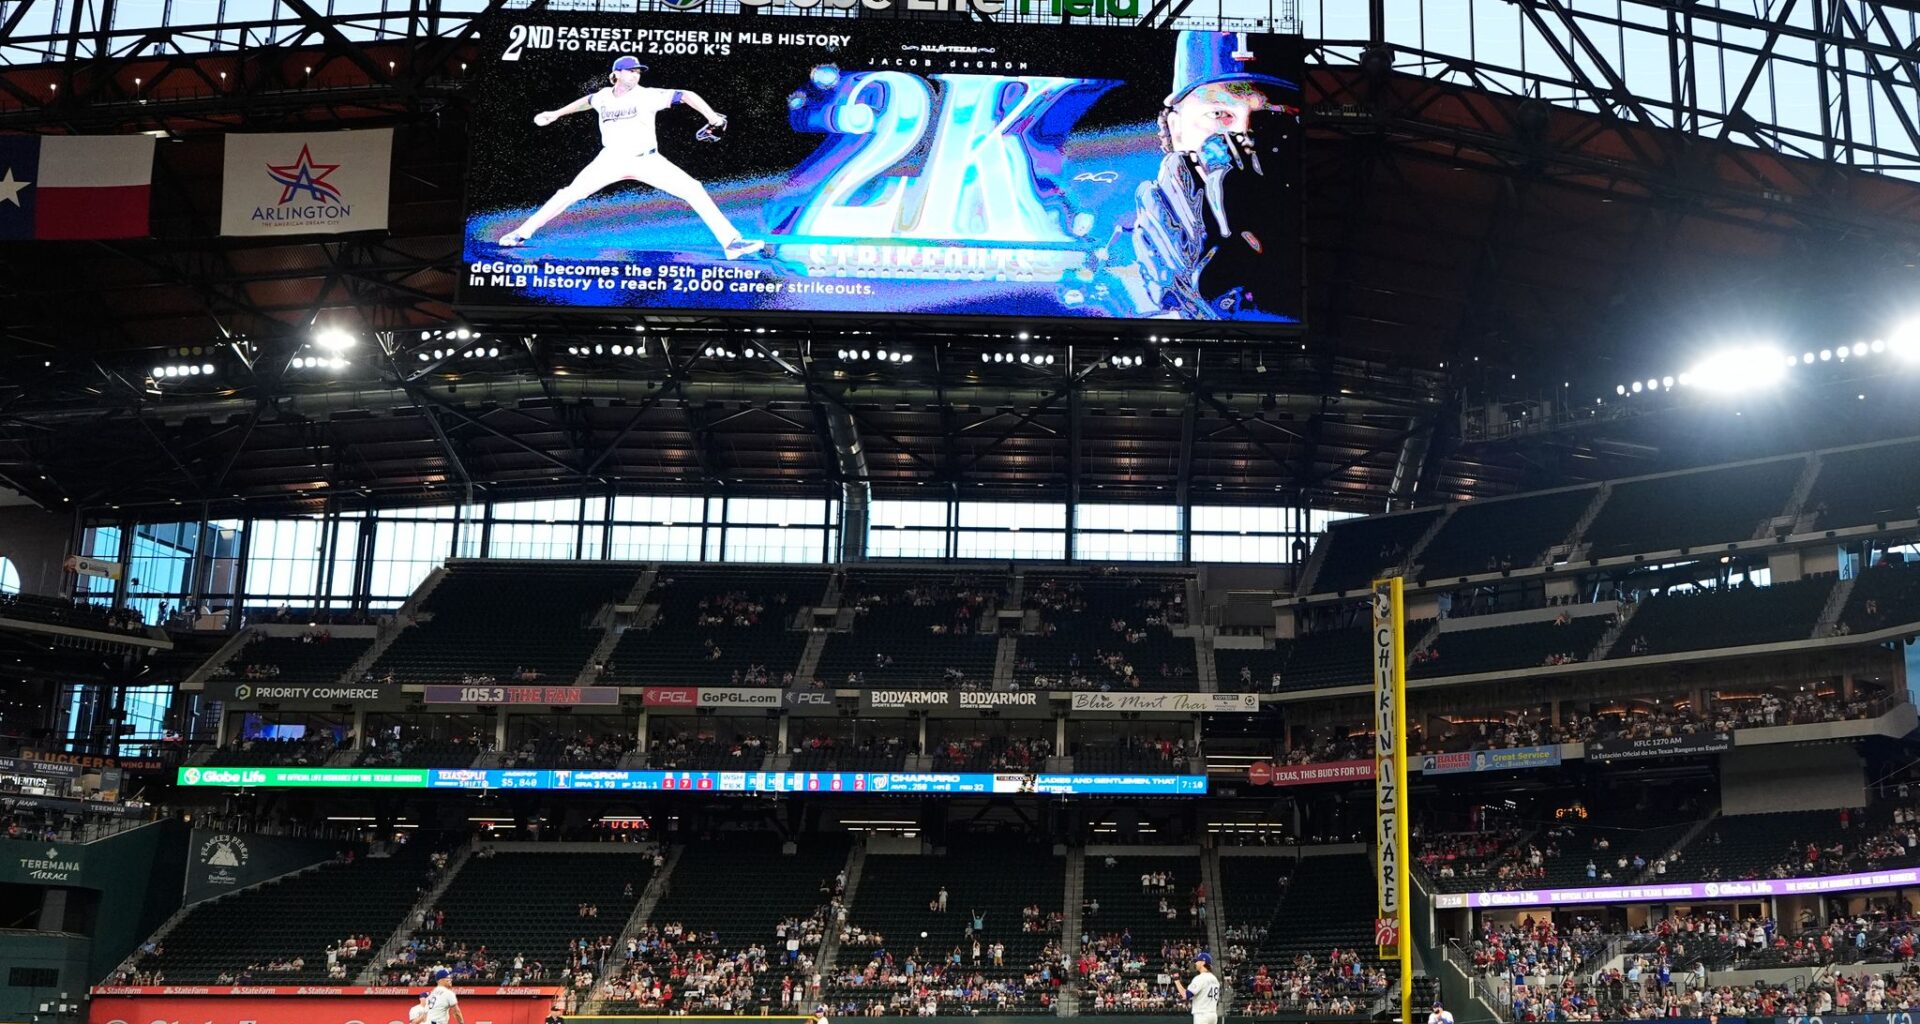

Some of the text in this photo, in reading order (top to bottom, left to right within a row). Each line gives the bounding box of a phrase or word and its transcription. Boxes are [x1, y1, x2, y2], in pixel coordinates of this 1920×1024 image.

[502, 25, 554, 61] 2ND
[558, 27, 851, 47] FASTEST PITCHER IN MLB HISTORY
[557, 39, 730, 56] TO REACH 2,000 K'S
[869, 58, 1027, 70] JACOB deGROM
[806, 70, 1078, 243] 2K
[252, 205, 351, 220] ARLINGTON
[470, 261, 761, 281] deGrom becomes the 95th pitcher
[469, 273, 876, 295] in MLB history to reach 2,000 career strikeouts.
[256, 687, 379, 700] PRIORITY COMMERCE
[460, 688, 582, 702] 105.3 THE FAN
[1376, 627, 1392, 752] CHIKIN
[659, 691, 692, 703] PGL
[702, 692, 777, 703] GoPGL.com
[797, 692, 831, 705] PGL
[871, 691, 949, 704] BODYARMOR
[960, 692, 1037, 706] BODYARMOR
[1075, 694, 1115, 709] Blue
[1119, 695, 1168, 709] Mint
[1634, 737, 1682, 747] KFLC 1270 AM
[1437, 752, 1471, 762] BAKER
[1492, 751, 1550, 763] Great Service
[1599, 751, 1622, 760] Estación
[1622, 749, 1640, 758] Oficial
[1658, 747, 1674, 755] Texas
[1674, 746, 1697, 756] Rangers
[1705, 743, 1728, 753] Español
[22, 751, 161, 769] PLUCKERS WING BAR
[33, 763, 74, 773] TEREMANA
[1276, 771, 1299, 781] TEXAS,
[1300, 769, 1316, 779] THIS
[1317, 768, 1339, 778] BUD'S
[1340, 767, 1355, 777] FOR
[1356, 766, 1371, 776] YOU
[202, 769, 267, 783] Globe Life
[575, 772, 629, 780] deGROM
[891, 775, 960, 783] CHAPARRO
[1039, 776, 1070, 784] LADIES
[1072, 777, 1094, 785] AND
[1152, 777, 1176, 785] THAT
[1381, 761, 1395, 804] IZ
[91, 805, 125, 813] TEREMANA
[20, 859, 80, 871] TEREMANA
[1382, 817, 1395, 909] FARE
[30, 870, 68, 881] TERRACE
[1719, 882, 1772, 896] Globe Life
[1491, 892, 1539, 904] Globe Life
[1208, 987, 1219, 1001] 48
